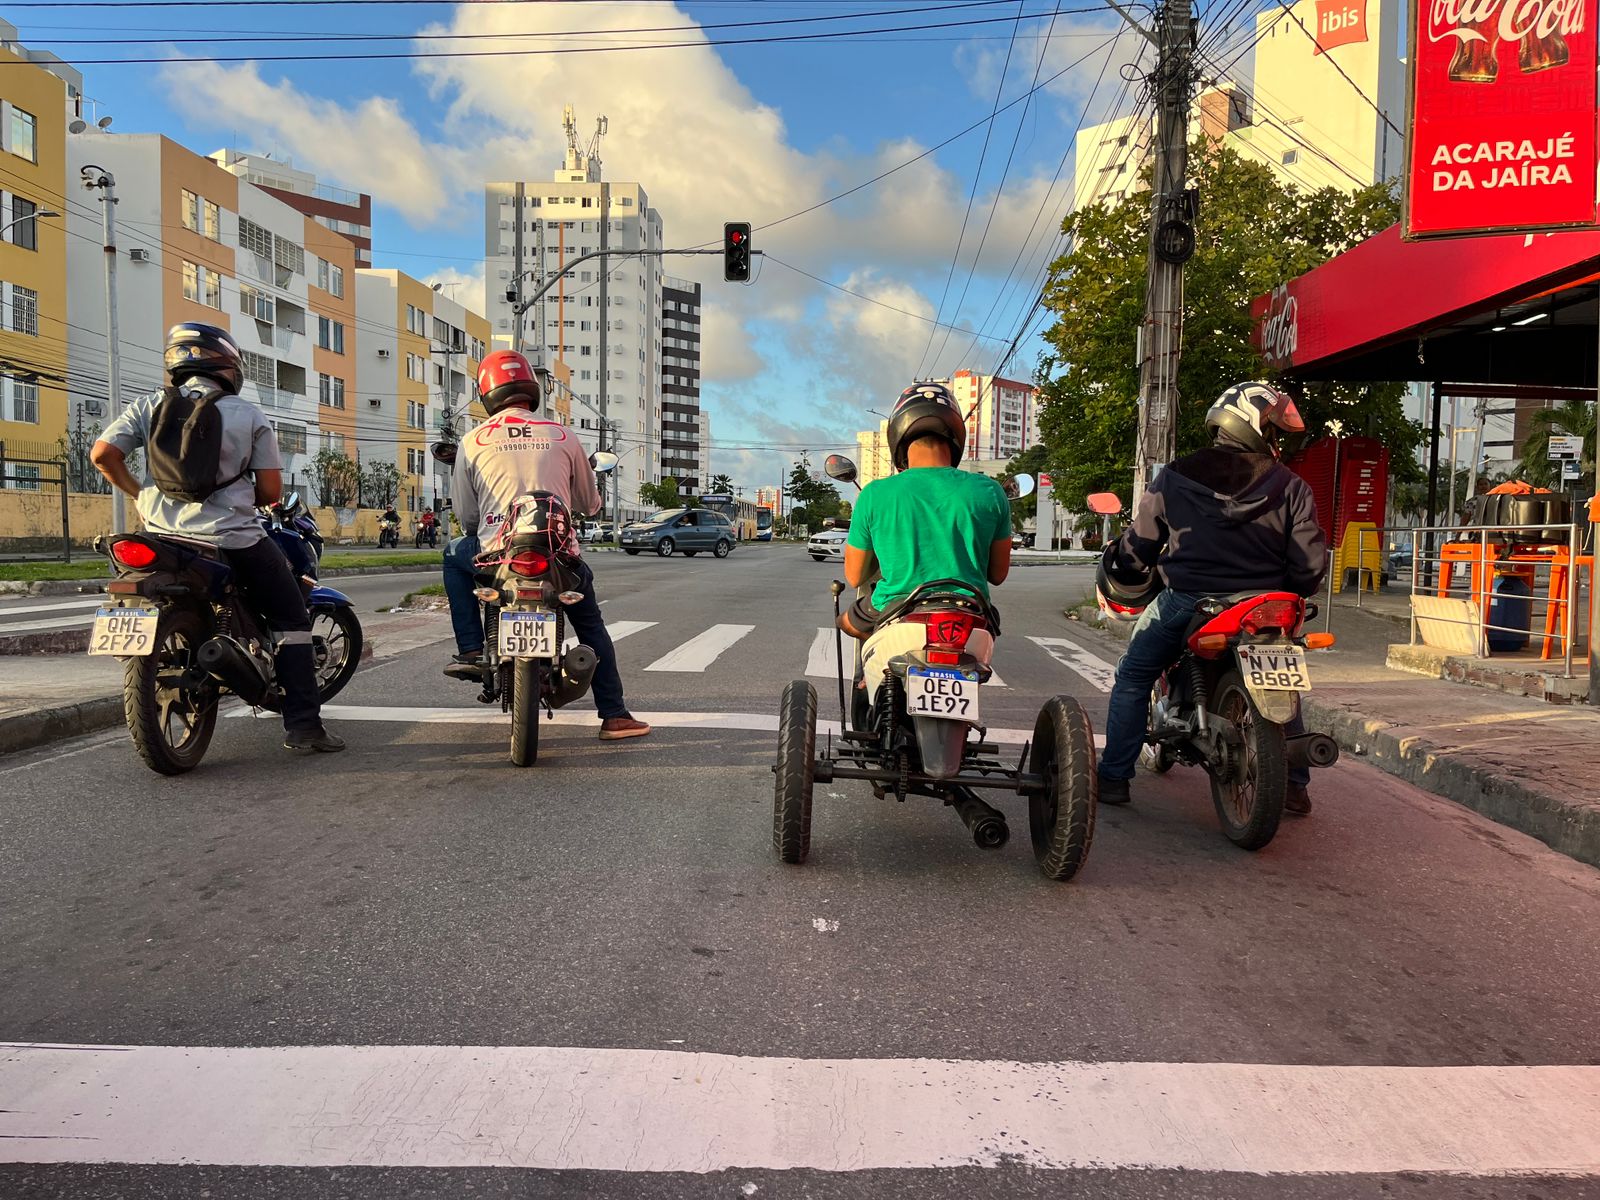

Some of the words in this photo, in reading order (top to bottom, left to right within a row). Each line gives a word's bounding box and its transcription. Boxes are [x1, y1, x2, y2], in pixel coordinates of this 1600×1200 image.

[1321, 7, 1359, 34] ibis
[1431, 132, 1575, 166] ACARAJÉ
[1432, 171, 1475, 191] DA
[1481, 161, 1573, 188] JAÍRA
[507, 424, 532, 438] DÉ
[107, 617, 145, 634] QME
[512, 621, 545, 637] QMM
[97, 634, 148, 651] 2F79
[506, 637, 549, 653] 5D91
[1249, 655, 1299, 672] NVH
[929, 671, 956, 680] BRASIL
[1250, 671, 1305, 688] 8582
[917, 694, 970, 715] 1E97
